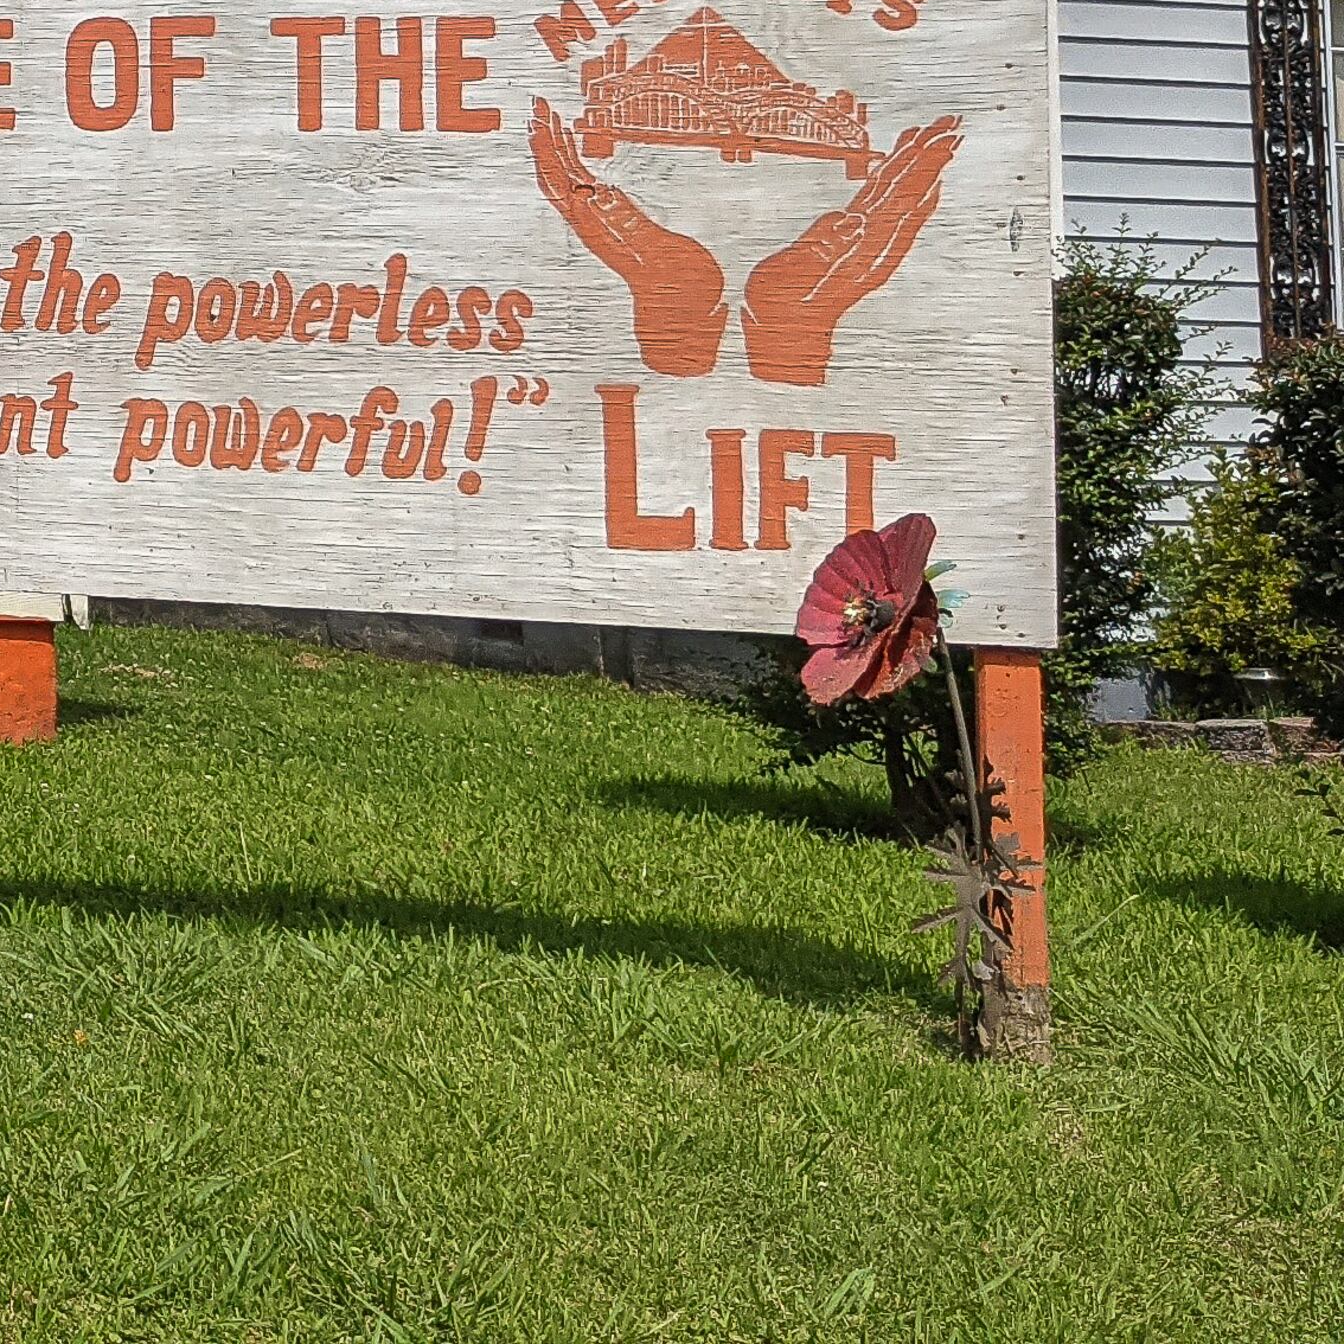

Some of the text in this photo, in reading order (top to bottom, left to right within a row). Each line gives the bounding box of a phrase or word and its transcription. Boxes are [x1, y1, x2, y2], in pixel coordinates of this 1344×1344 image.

[66, 16, 219, 133] OF
[269, 15, 503, 134] THE
[134, 254, 536, 370] powerless
[113, 376, 552, 497] powerful!"
[594, 383, 897, 552] LIFT
